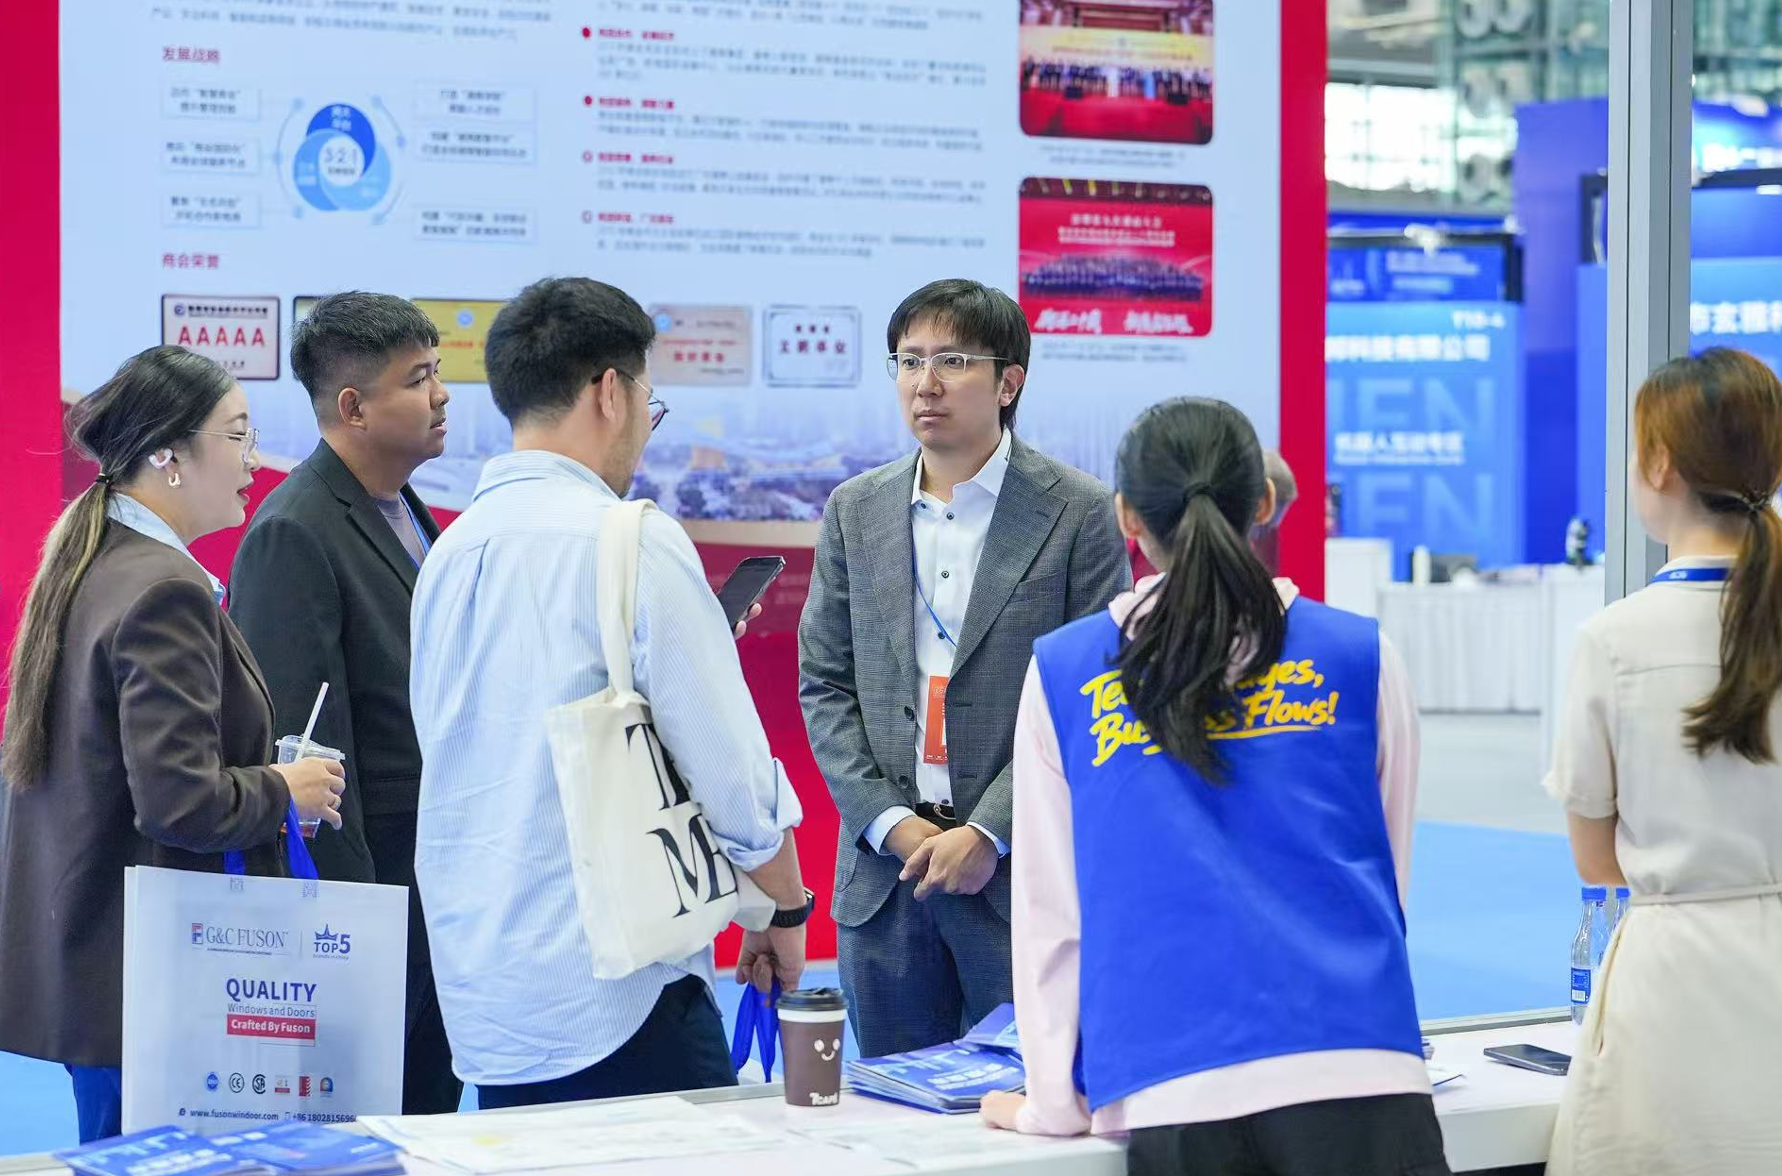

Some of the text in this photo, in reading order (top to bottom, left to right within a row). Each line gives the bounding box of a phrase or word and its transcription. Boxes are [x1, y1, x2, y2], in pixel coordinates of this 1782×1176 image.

[178, 325, 266, 346] AAAAA
[1242, 689, 1339, 728] Flows!
[206, 926, 285, 949] G&C FUSON
[226, 978, 317, 1002] QUALITY
[228, 1003, 315, 1018] Windows and Doors
[231, 1019, 311, 1034] Crafted By Fuson
